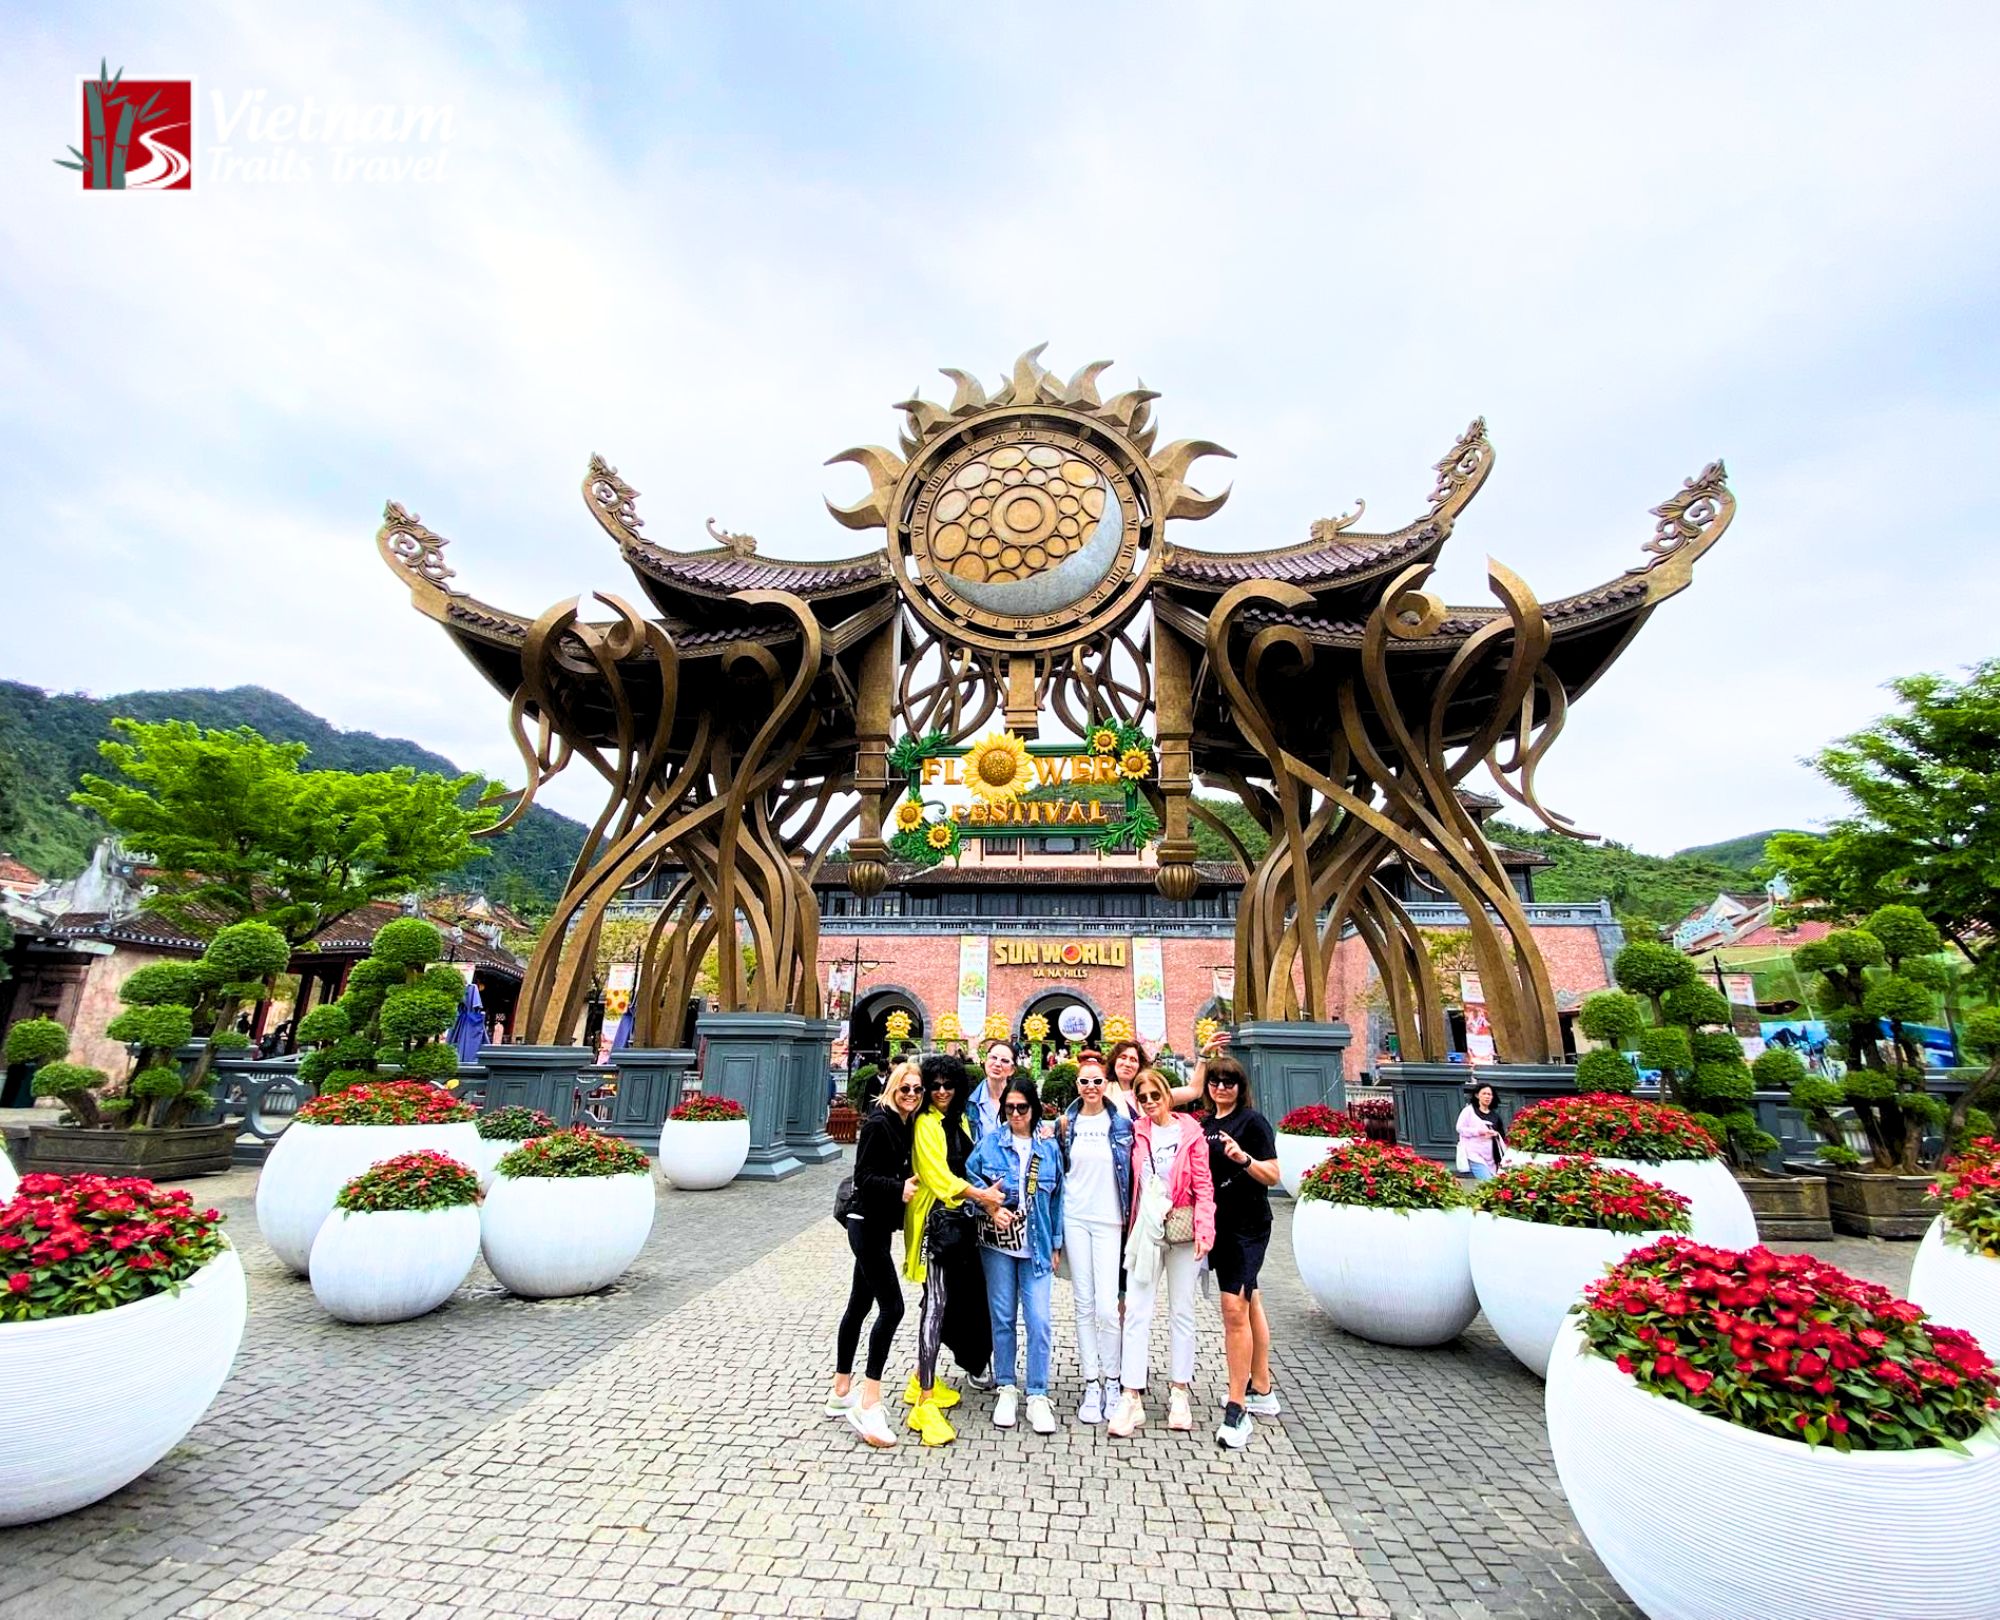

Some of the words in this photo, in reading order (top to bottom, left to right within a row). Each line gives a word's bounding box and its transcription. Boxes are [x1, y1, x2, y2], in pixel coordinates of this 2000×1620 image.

[951, 799, 1108, 824] FESTIVAL
[994, 940, 1039, 966] SUN
[1040, 942, 1126, 968] WORLD
[1063, 968, 1088, 979] HILLS
